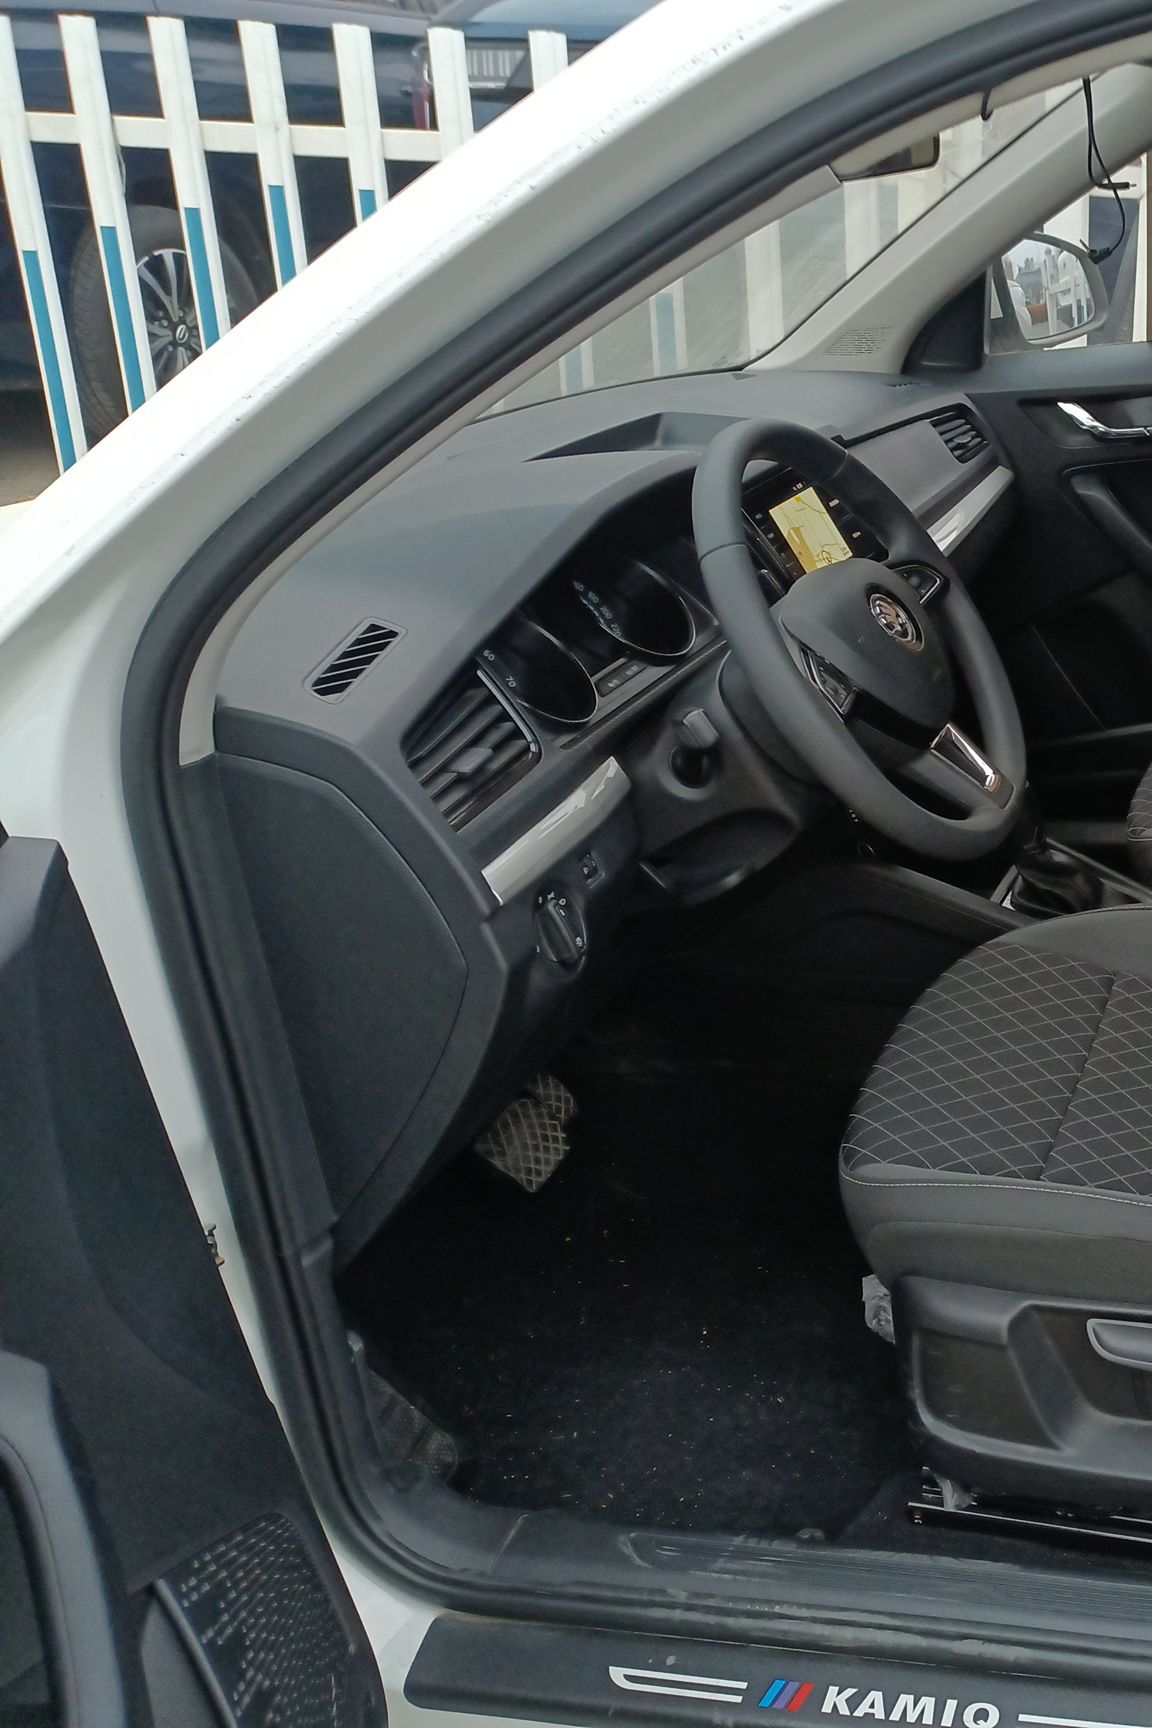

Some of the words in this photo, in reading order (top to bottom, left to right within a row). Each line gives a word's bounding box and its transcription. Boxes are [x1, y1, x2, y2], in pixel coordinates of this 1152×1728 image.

[600, 605, 612, 619] 200
[483, 649, 495, 661] 60
[505, 675, 516, 687] 70
[820, 1685, 1000, 1728] KAMIQ
